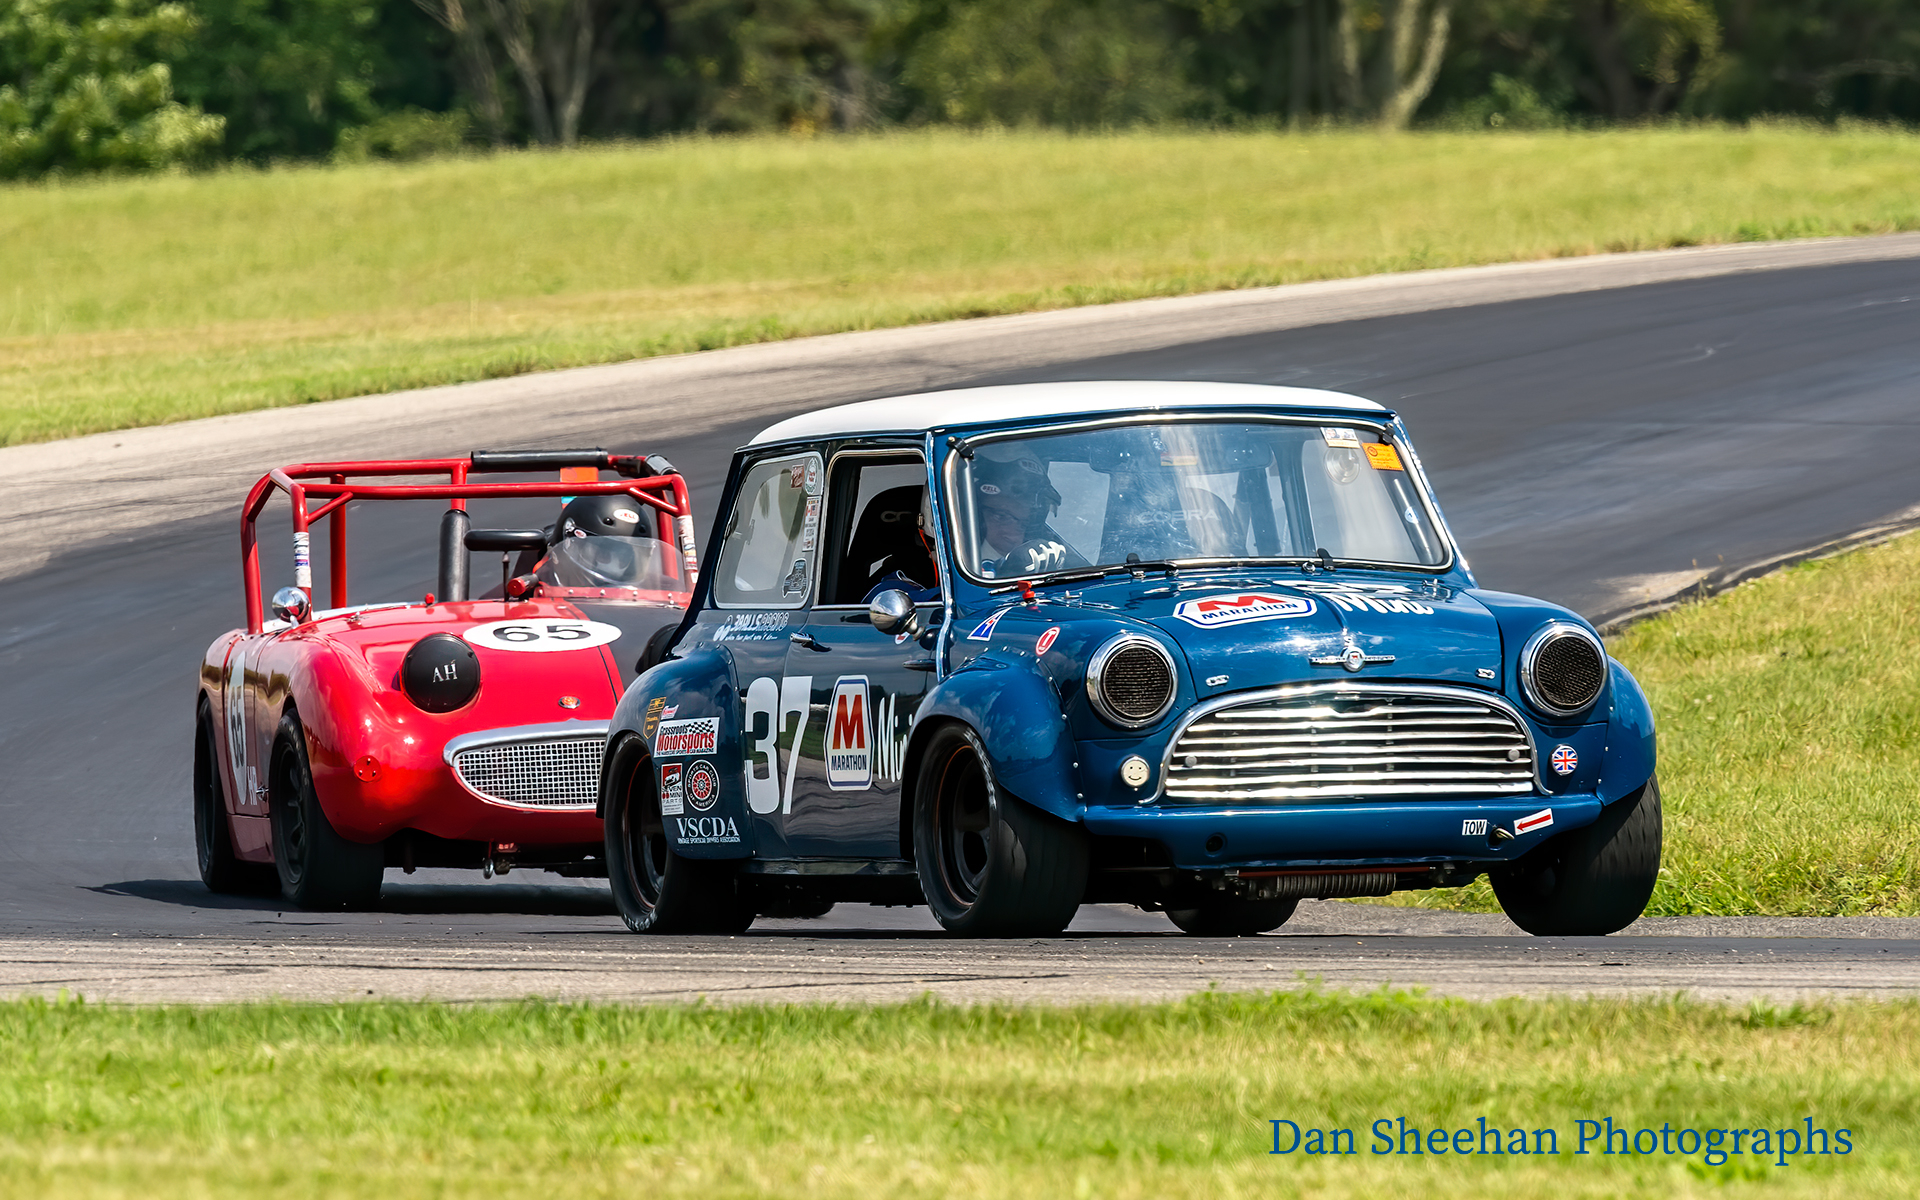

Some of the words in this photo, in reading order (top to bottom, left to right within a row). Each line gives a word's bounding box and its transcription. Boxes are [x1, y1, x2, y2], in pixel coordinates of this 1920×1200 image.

[982, 485, 998, 493] BELL
[1201, 603, 1299, 620] MARATHON
[1319, 592, 1434, 615] Mini
[493, 624, 591, 642] 65
[432, 660, 458, 683] AH
[659, 723, 688, 736] Grassroots
[656, 732, 715, 754] Motorsports
[744, 676, 813, 815] 37
[831, 754, 867, 771] MARATHON
[676, 816, 740, 837] VSCDA
[1465, 821, 1486, 835] TOW
